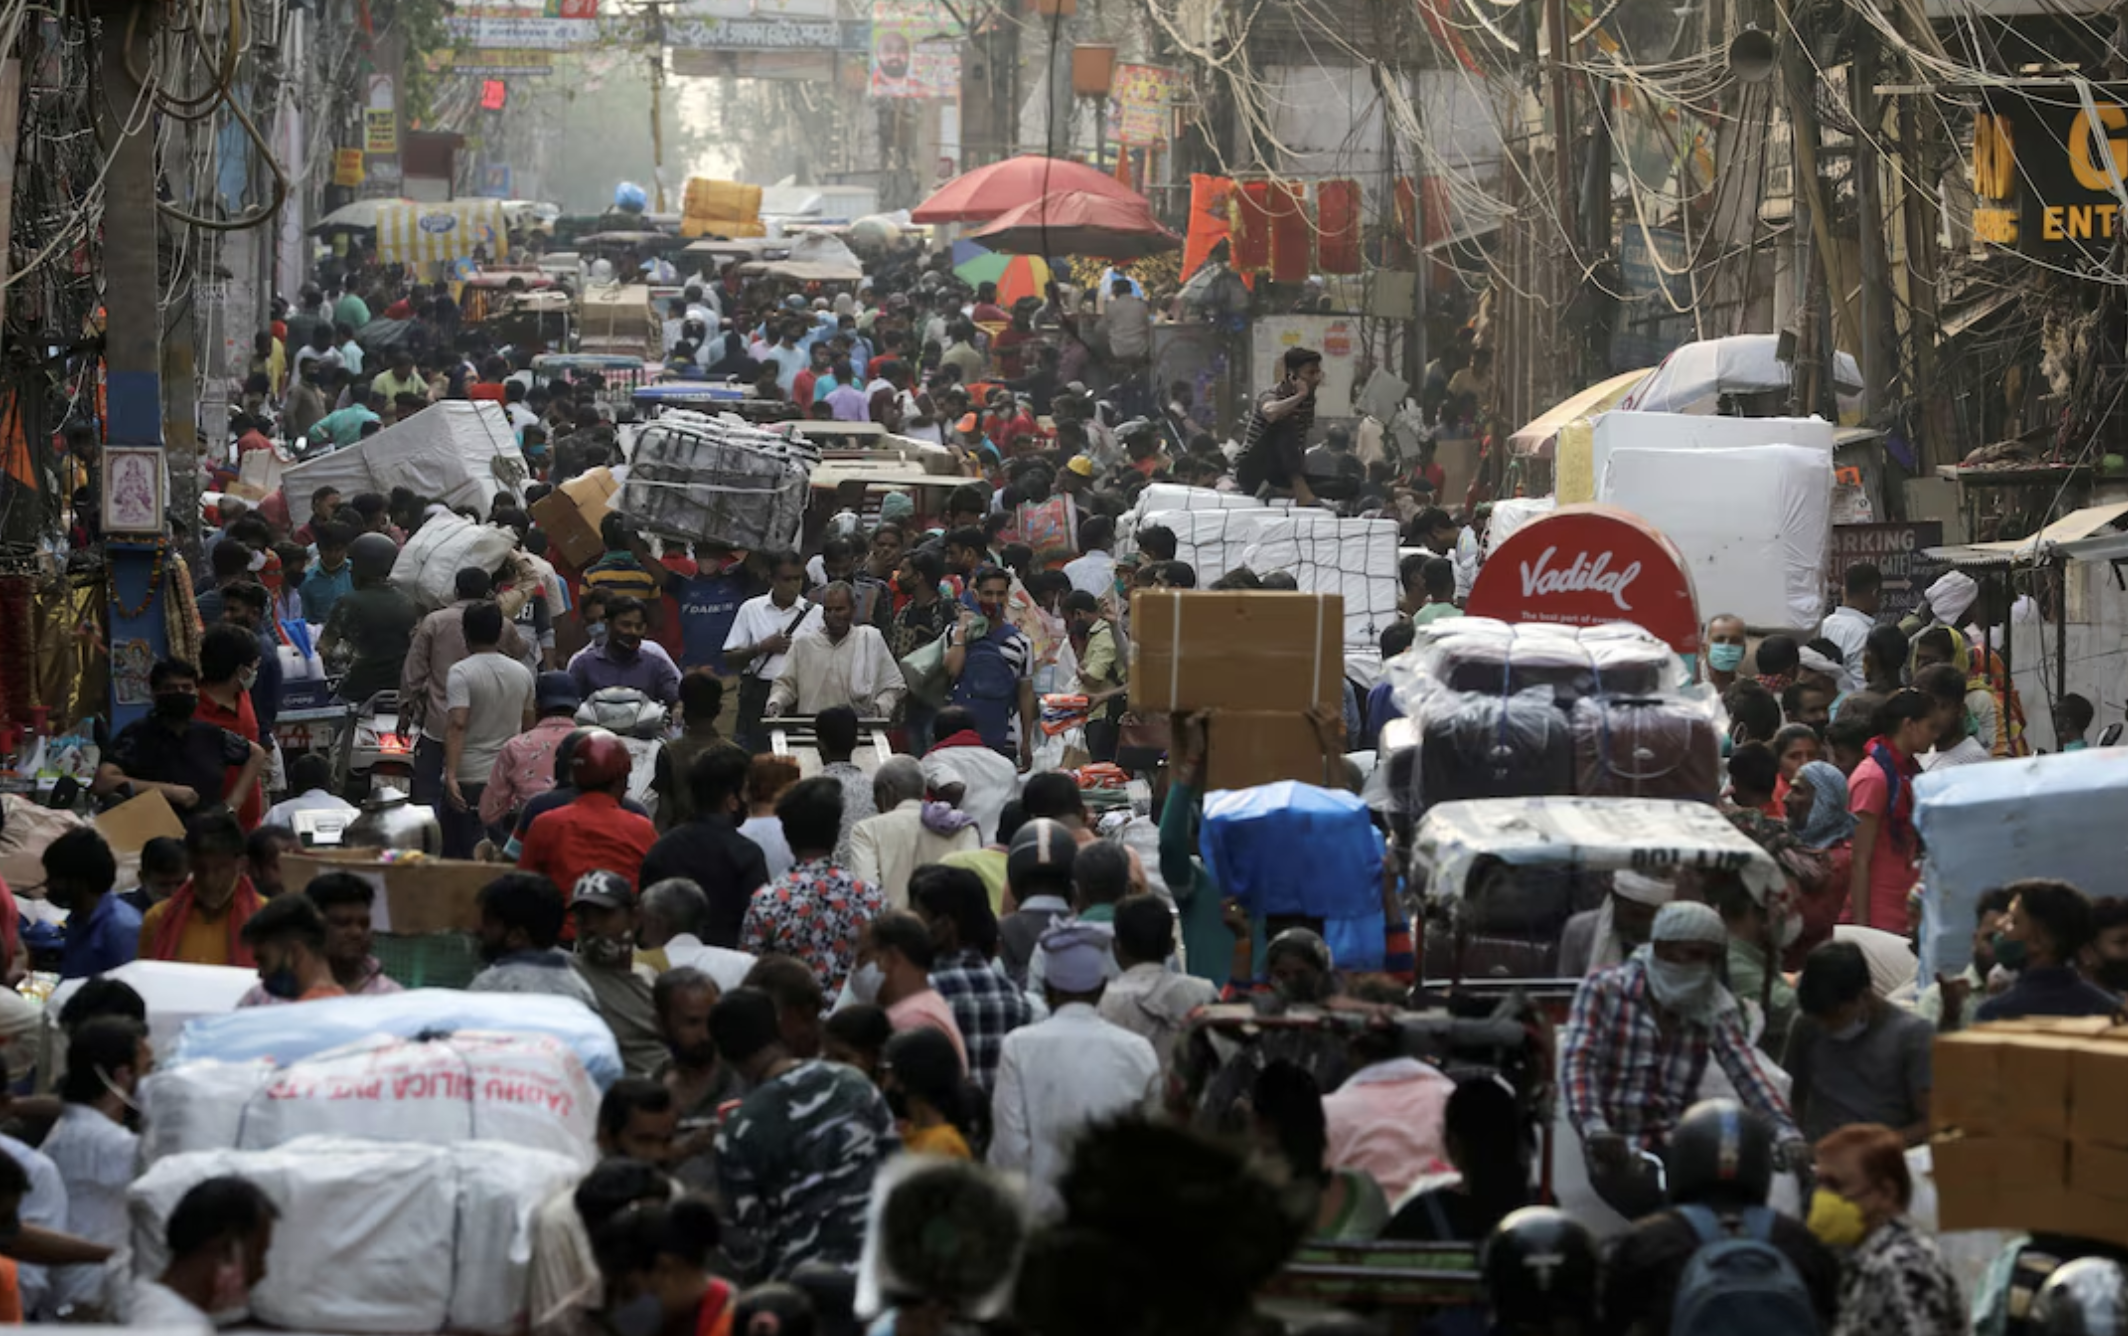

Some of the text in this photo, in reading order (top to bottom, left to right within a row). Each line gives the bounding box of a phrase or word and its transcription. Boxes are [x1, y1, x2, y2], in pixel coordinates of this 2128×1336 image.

[2068, 100, 2128, 191] G
[2043, 204, 2120, 241] ENT
[1520, 546, 1642, 611] Vadilal
